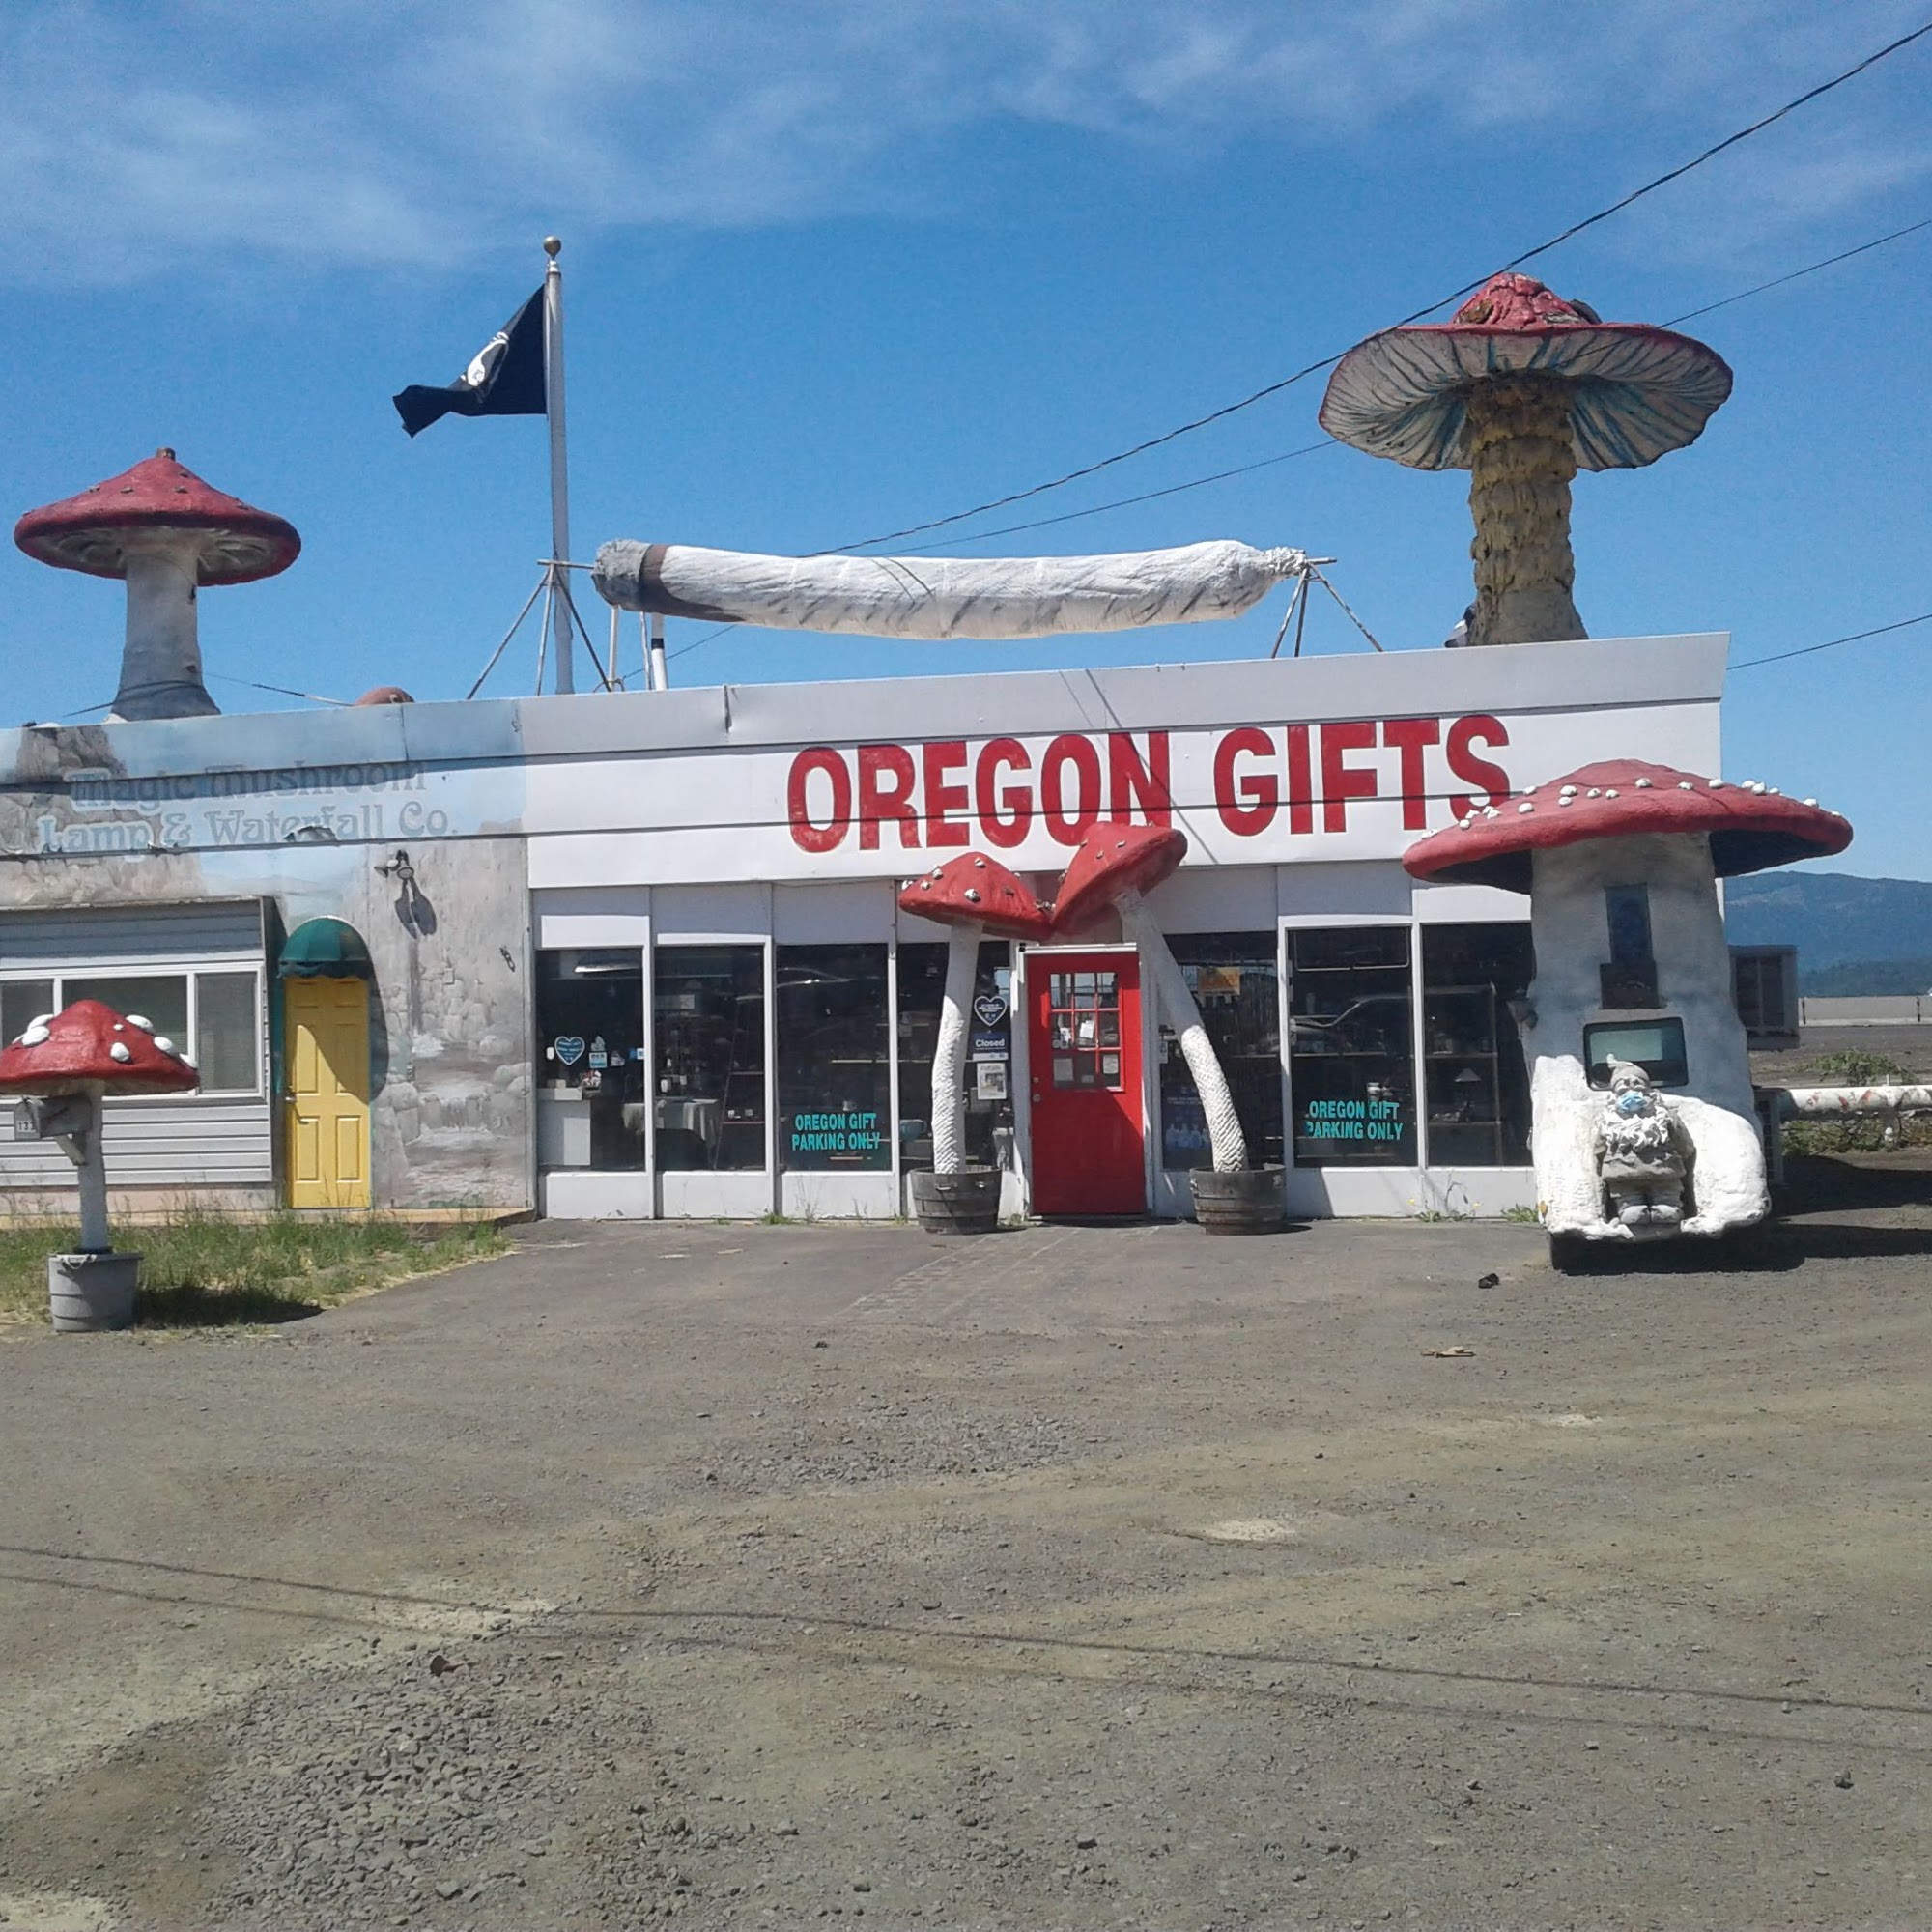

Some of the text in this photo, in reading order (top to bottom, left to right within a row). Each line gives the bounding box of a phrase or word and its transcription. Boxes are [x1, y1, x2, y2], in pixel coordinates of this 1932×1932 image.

[787, 714, 1511, 854] OREGON GIFTS
[162, 811, 192, 848] &
[399, 801, 459, 838] Co.
[975, 1038, 1006, 1048] Closed
[1309, 1100, 1400, 1120] OREGON GIFT
[795, 1112, 877, 1131] OREGON GIFT
[1304, 1121, 1404, 1141] PARKING ONLY
[792, 1131, 881, 1151] PARKING ONLY
